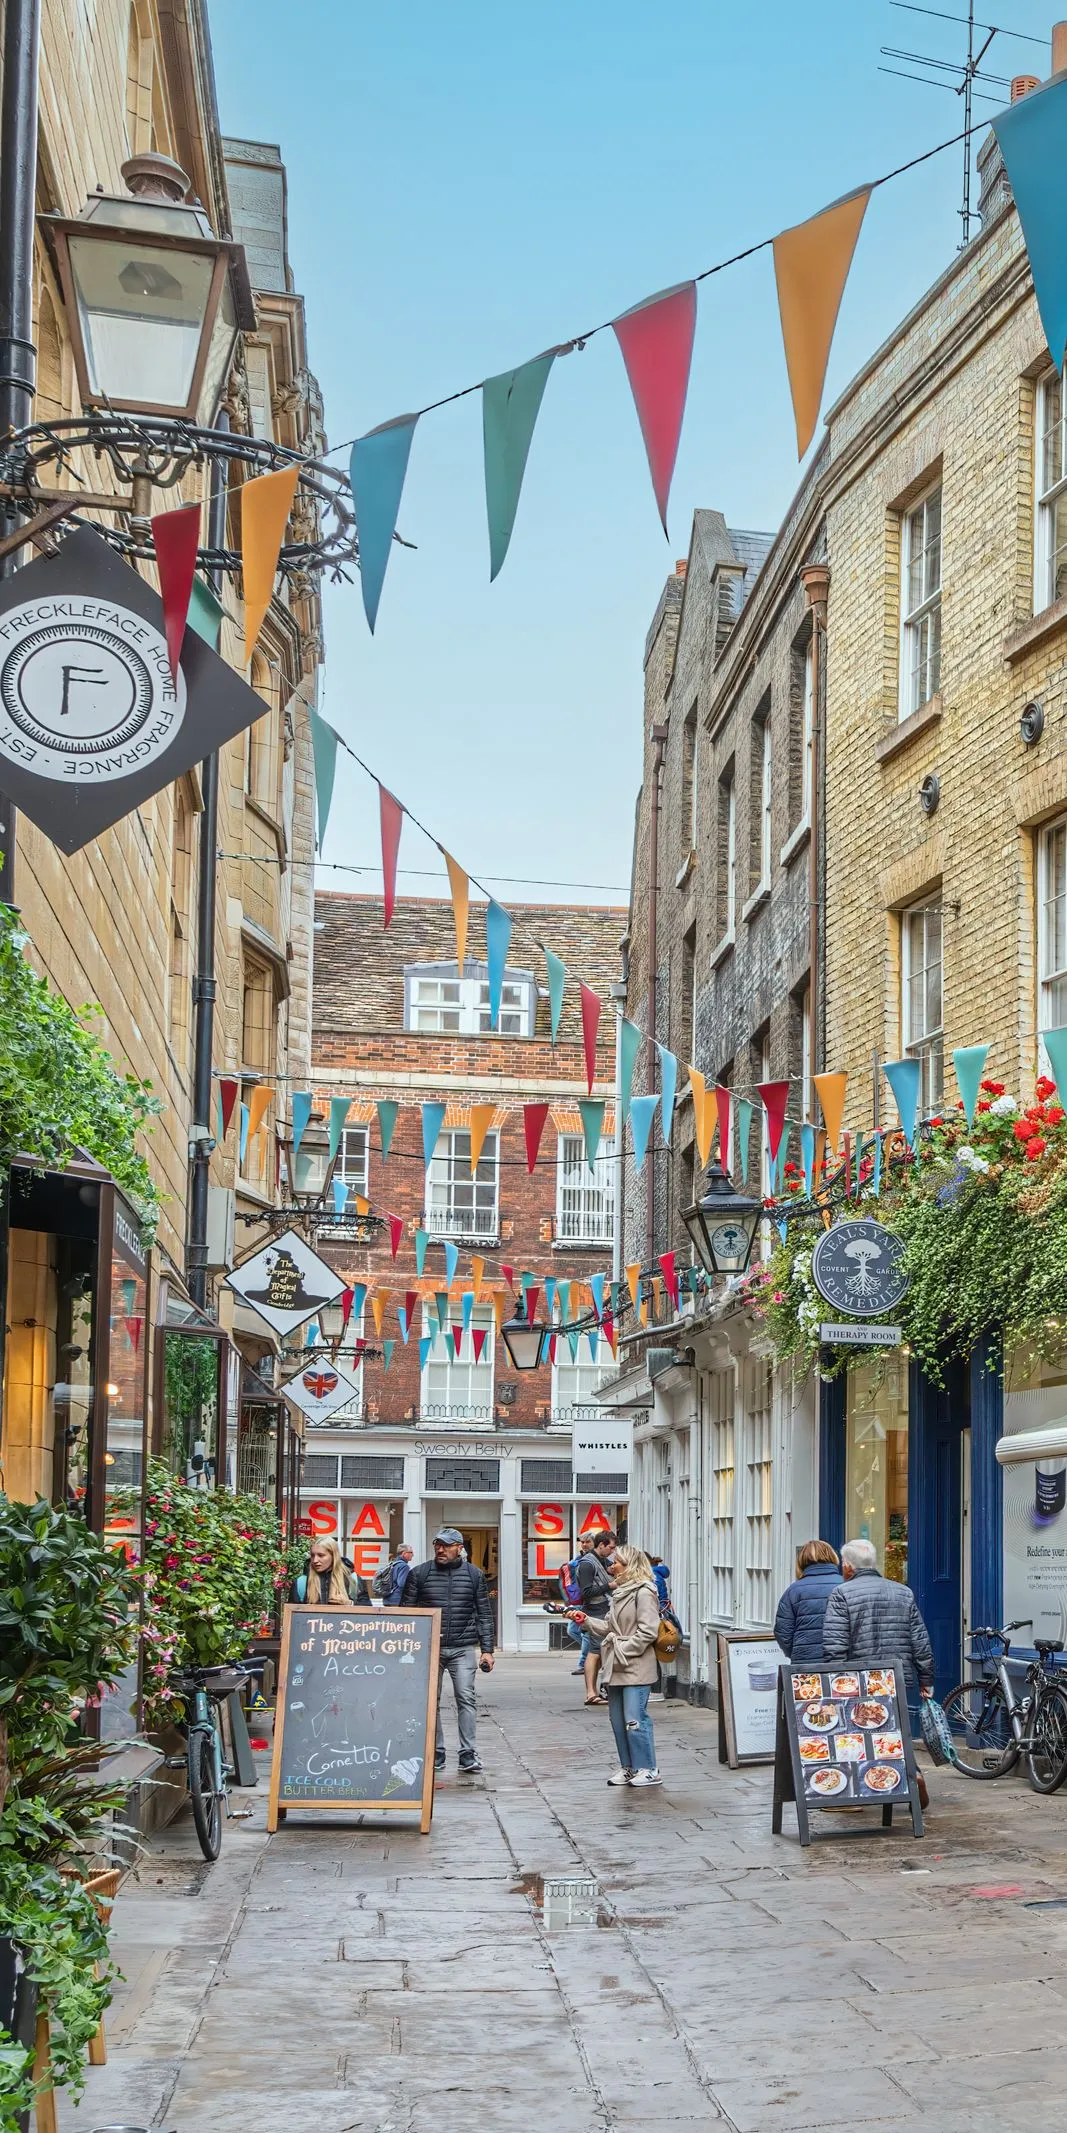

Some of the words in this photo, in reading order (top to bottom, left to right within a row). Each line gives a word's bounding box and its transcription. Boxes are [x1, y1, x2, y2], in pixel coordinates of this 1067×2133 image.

[0, 602, 150, 644] FRECKLEFACE
[148, 646, 177, 702] HOME
[61, 666, 110, 715] F
[63, 711, 174, 775] FRAGRANCE
[821, 1226, 867, 1261] NEAL'S
[280, 1260, 293, 1268] The
[820, 1265, 850, 1273] COVENT
[270, 1283, 297, 1293] Magical
[271, 1293, 293, 1301] Gifts
[827, 1331, 868, 1339] THERAPY
[871, 1333, 896, 1341] ROOM
[414, 1440, 471, 1456] Sweaty
[475, 1442, 513, 1458] Betty
[1026, 1545, 1051, 1558] Redefine
[307, 1618, 334, 1634] The
[338, 1619, 417, 1637] Department
[300, 1637, 316, 1652] of
[321, 1638, 377, 1656] Magical
[381, 1638, 421, 1655] Gifts
[285, 1775, 312, 1785] ICE
[315, 1777, 352, 1787] COLD
[284, 1785, 335, 1796] BUTTER
